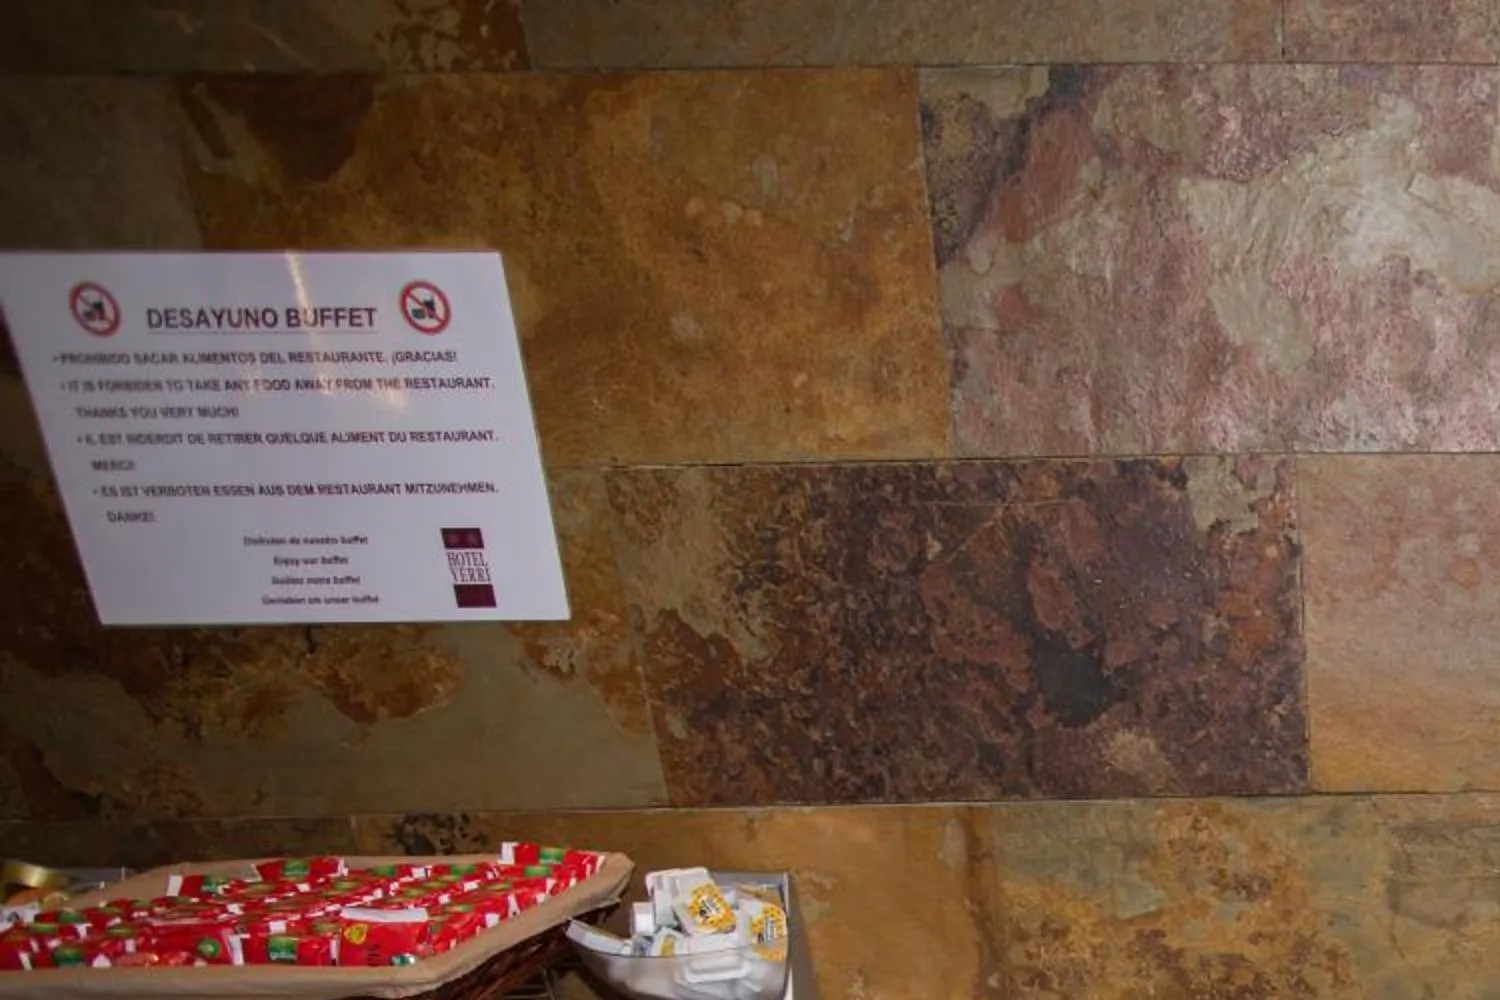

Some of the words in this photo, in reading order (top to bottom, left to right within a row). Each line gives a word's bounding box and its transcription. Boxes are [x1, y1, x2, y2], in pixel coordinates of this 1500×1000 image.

[147, 307, 279, 329] DESAYUNO
[286, 307, 378, 329] BUFFET
[134, 352, 179, 365] SACAR
[260, 351, 286, 364] DEL
[83, 379, 95, 392] IS
[167, 379, 184, 392] TO
[188, 379, 221, 391] TAKE
[224, 379, 251, 392] ANY
[254, 378, 291, 391] FOOD
[295, 378, 332, 391] AWAY
[336, 378, 373, 390] FROM
[376, 378, 401, 390] THE
[131, 407, 158, 419] YOU
[161, 407, 193, 419] VERY
[100, 432, 123, 445] EST
[187, 432, 205, 445] DE
[208, 432, 263, 445] RETIRER
[266, 432, 328, 444] QUELQUE
[331, 431, 385, 443] ALIMENT
[389, 431, 407, 443] DU
[101, 485, 119, 497] ES
[121, 485, 139, 497] IST
[143, 485, 211, 497] VERBOTEN
[214, 484, 255, 496] ESSEN
[259, 484, 285, 496] AUS
[287, 484, 315, 495] DEM
[318, 483, 401, 496] RESTAURANT
[446, 551, 489, 567] HOTEL
